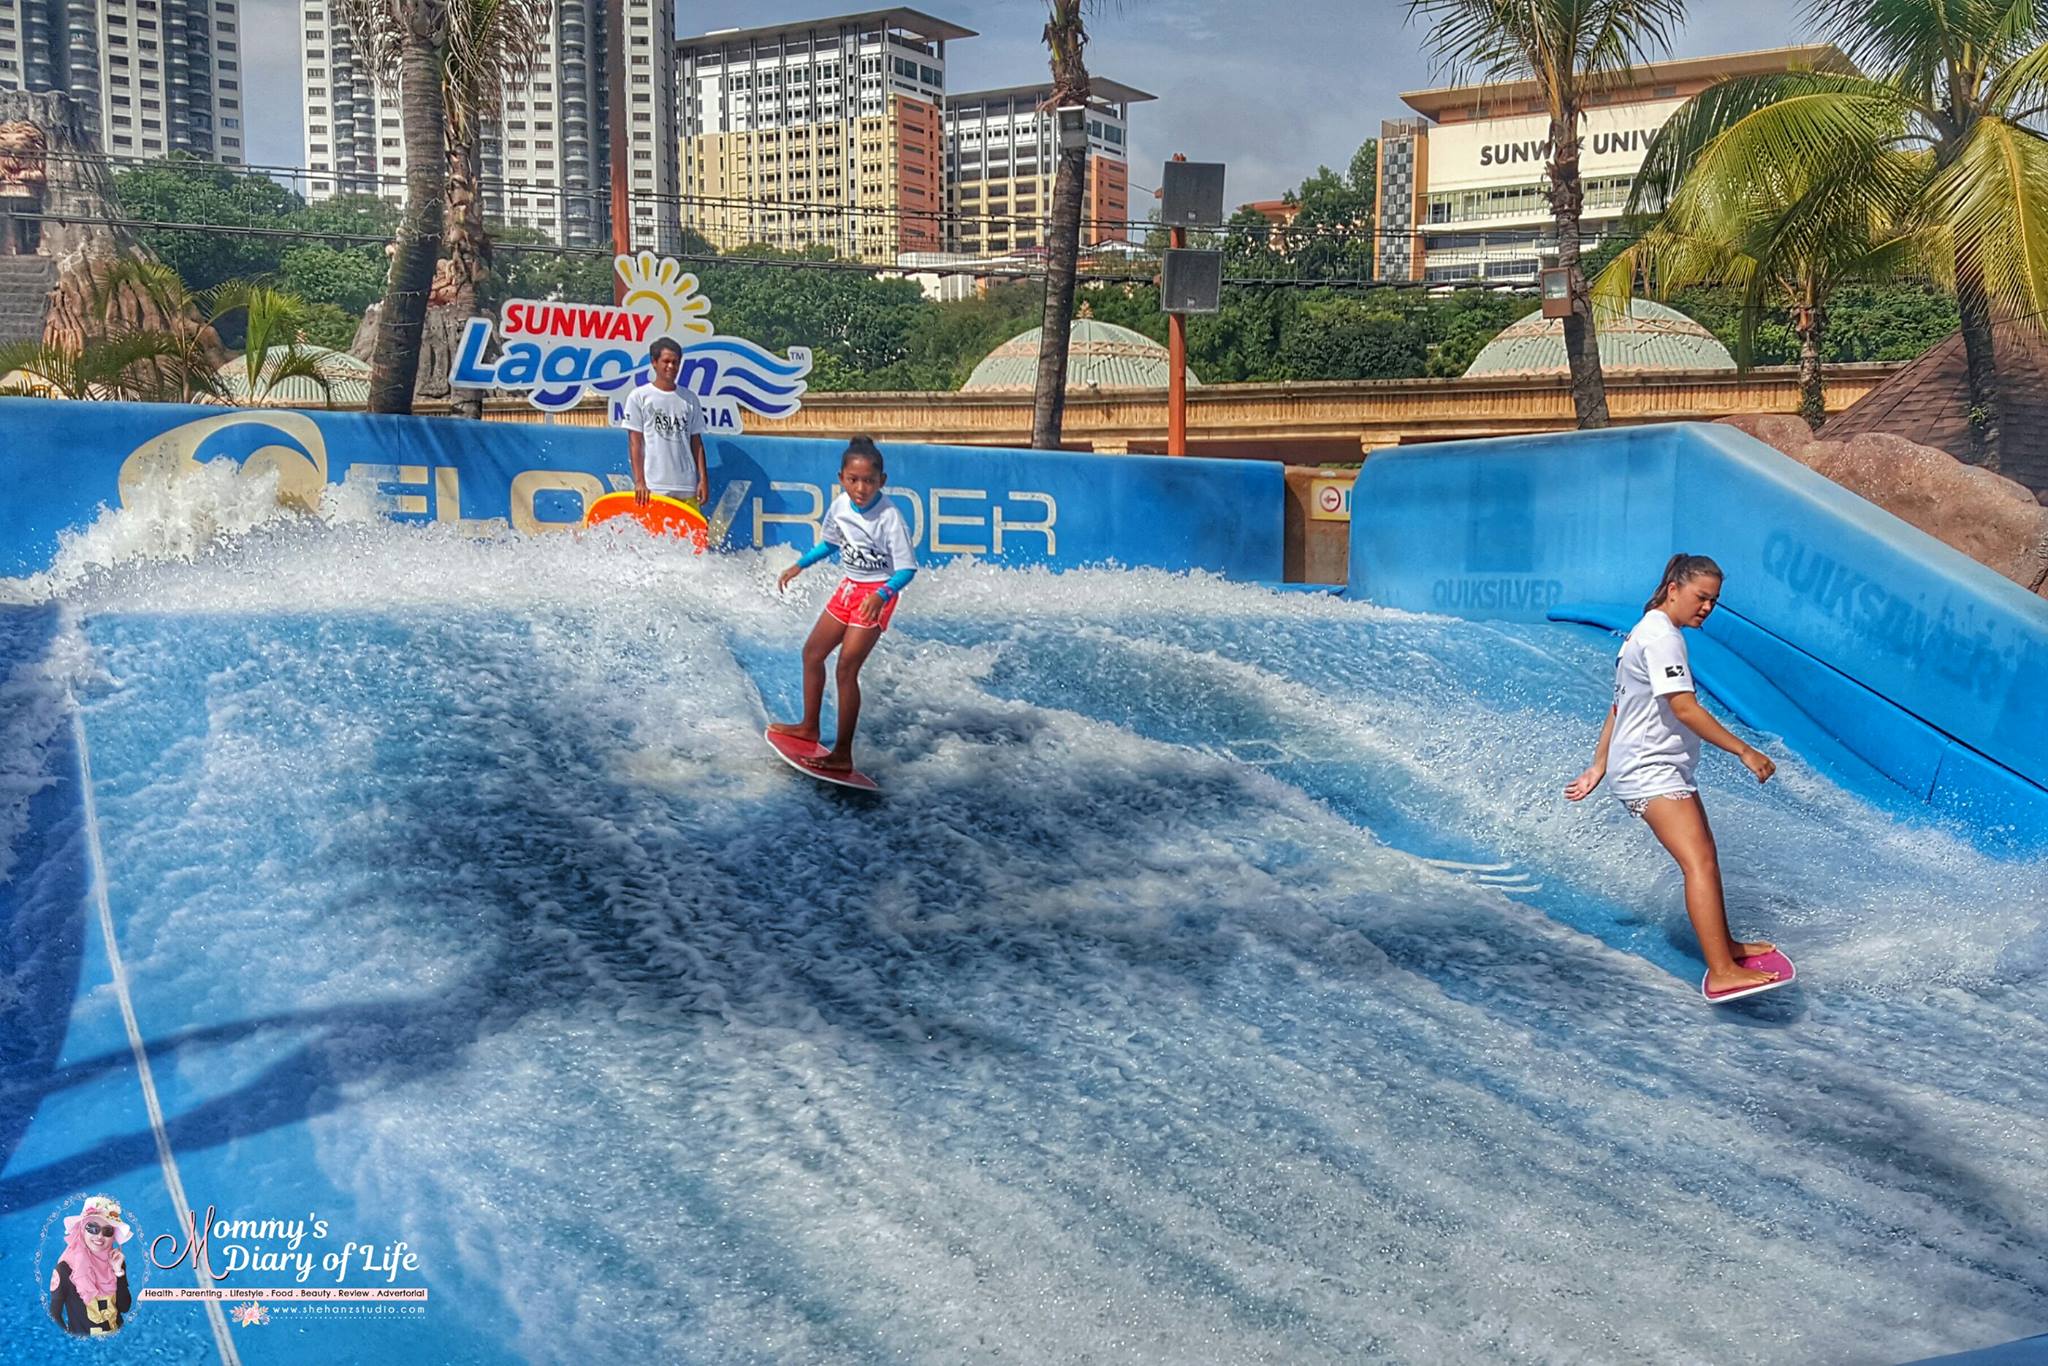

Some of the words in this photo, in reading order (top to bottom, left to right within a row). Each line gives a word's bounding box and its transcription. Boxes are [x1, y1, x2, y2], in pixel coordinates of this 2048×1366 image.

[1480, 136, 1585, 166] SUNW
[1593, 128, 1658, 155] UNIV
[506, 304, 654, 342] SUNWAY
[1432, 579, 1562, 608] QUIKSILVER
